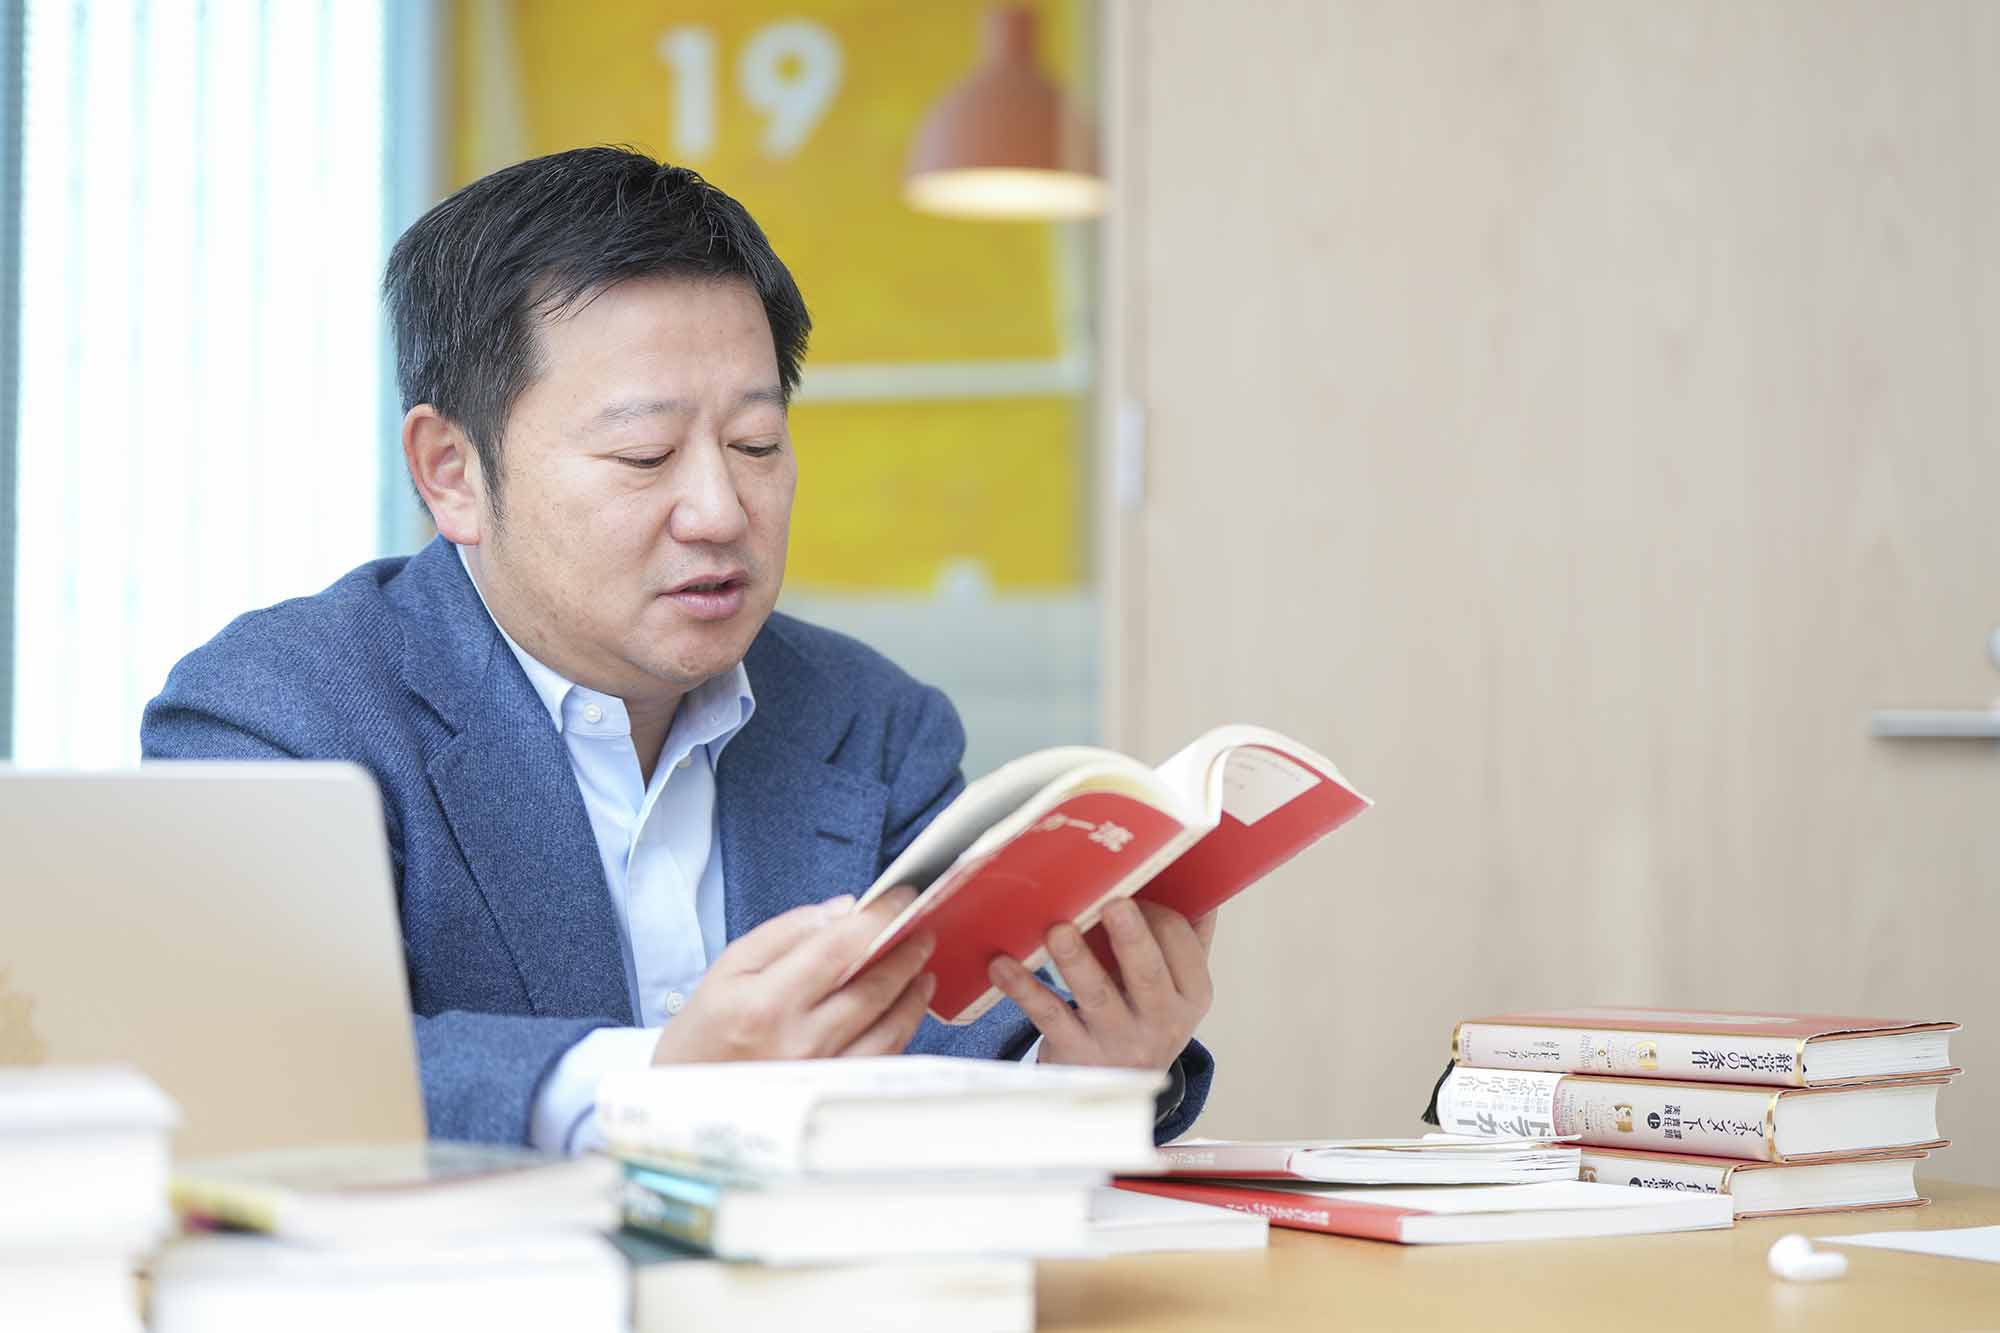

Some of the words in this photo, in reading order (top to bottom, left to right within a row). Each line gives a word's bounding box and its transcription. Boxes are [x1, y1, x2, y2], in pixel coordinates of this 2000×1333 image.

[659, 20, 845, 160] 19
[1691, 1049, 1793, 1073] 経営者の条件
[1456, 1111, 1551, 1137] ドラッカー
[1683, 1119, 1764, 1137] マネジメント
